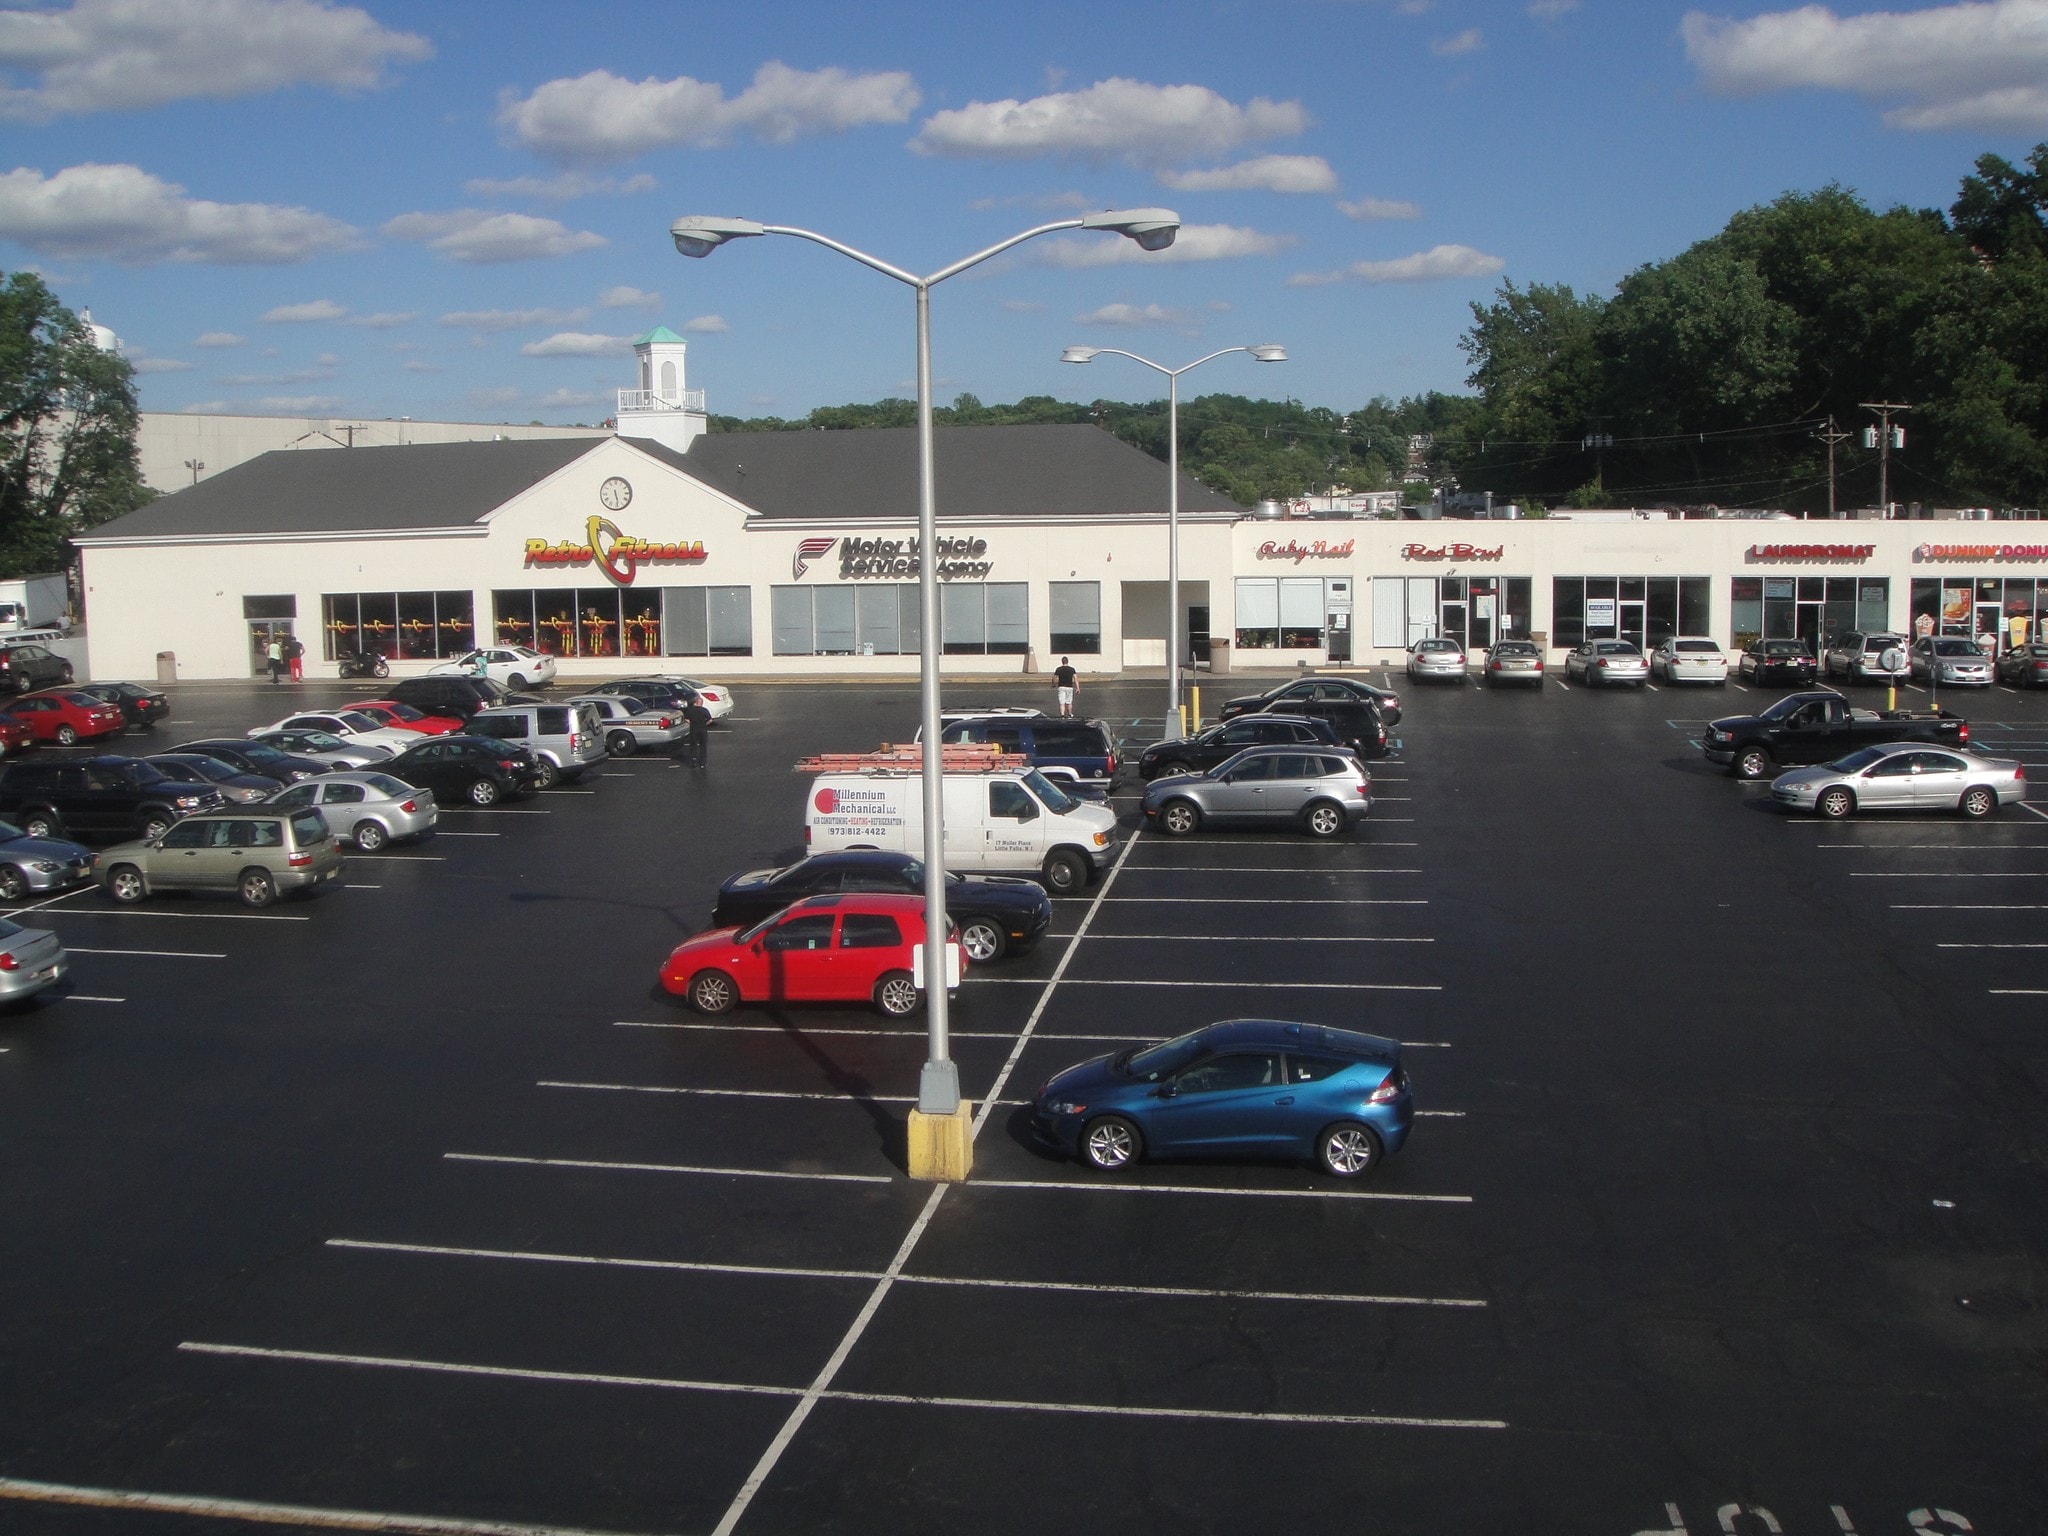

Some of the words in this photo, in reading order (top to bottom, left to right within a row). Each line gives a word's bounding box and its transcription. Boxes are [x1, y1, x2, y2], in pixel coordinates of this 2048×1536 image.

[525, 538, 595, 563] Retro
[609, 536, 709, 561] Fitness
[842, 537, 904, 555] Motor
[909, 535, 987, 555] Vhicle
[1260, 539, 1310, 560] Ruby
[1311, 538, 1355, 554] Nail
[1405, 543, 1447, 558] Red
[1450, 543, 1504, 558] Bowl
[1751, 544, 1877, 558] LAUNDROMAT
[1932, 544, 2001, 558] DUNKIN'
[842, 555, 920, 574] Service
[938, 559, 994, 581] Agency
[833, 789, 886, 800] Millennium
[833, 803, 886, 814] Mechanical
[813, 817, 821, 825] AIR
[821, 817, 848, 825] CONDITIONING
[850, 817, 868, 825] HEATING
[870, 817, 902, 825] REFRIGERATION
